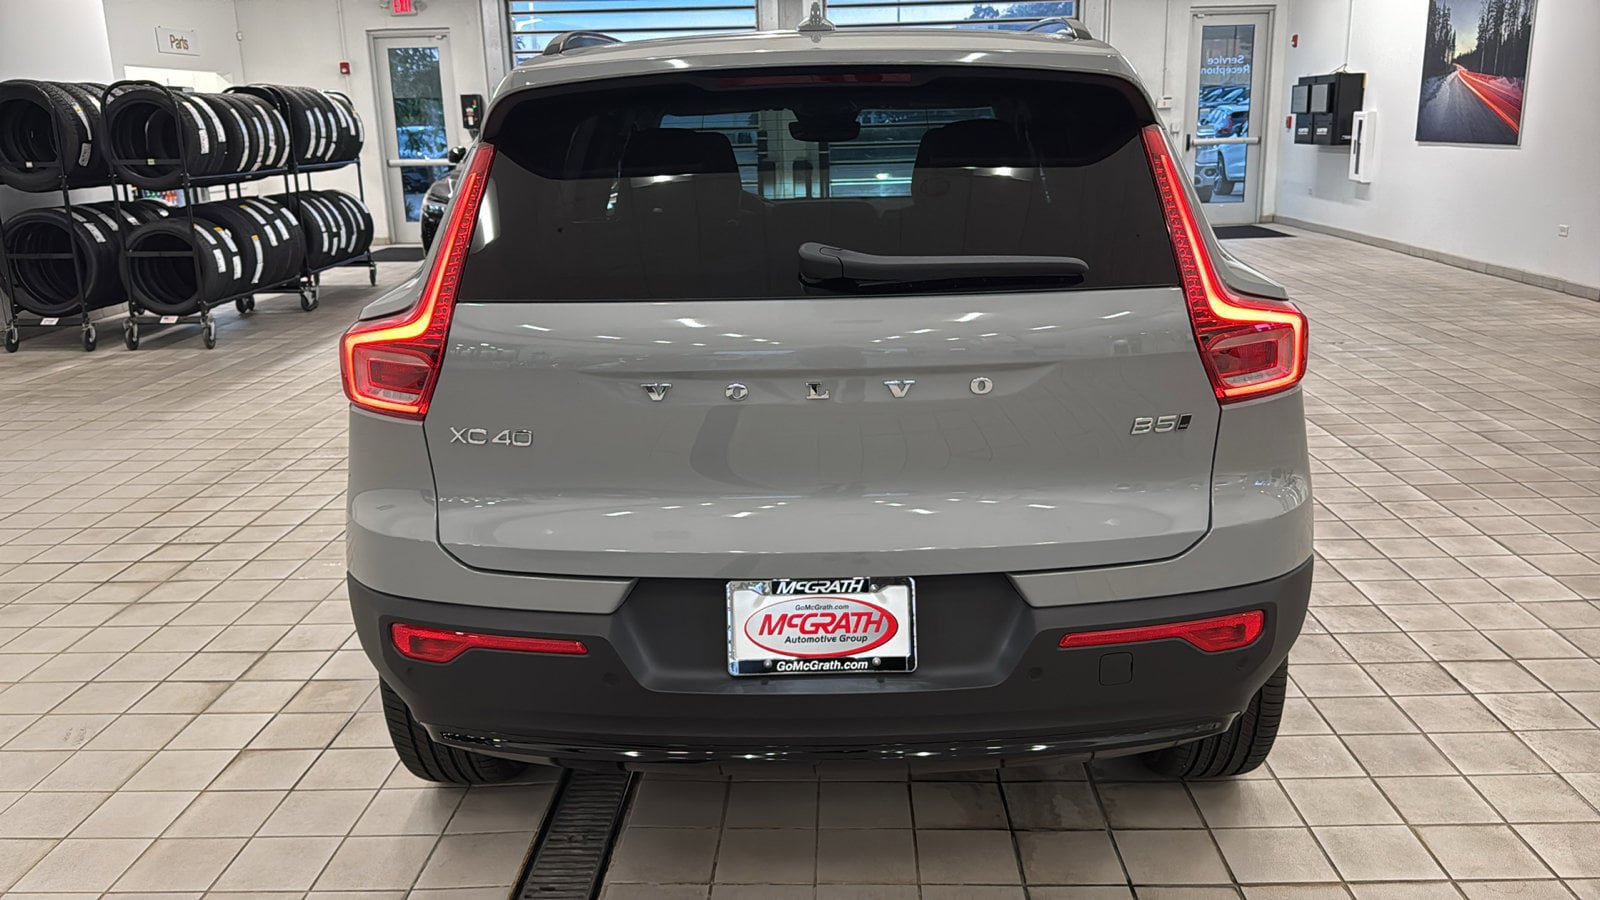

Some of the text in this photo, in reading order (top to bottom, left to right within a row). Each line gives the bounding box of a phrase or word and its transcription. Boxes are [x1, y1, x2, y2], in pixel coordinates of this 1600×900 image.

[640, 376, 994, 401] VOLVO
[1131, 414, 1177, 435] B5
[794, 603, 850, 612] GoMcGrath.com
[784, 634, 868, 644] Automotive Group
[776, 659, 869, 672] GoMcGrath.com
